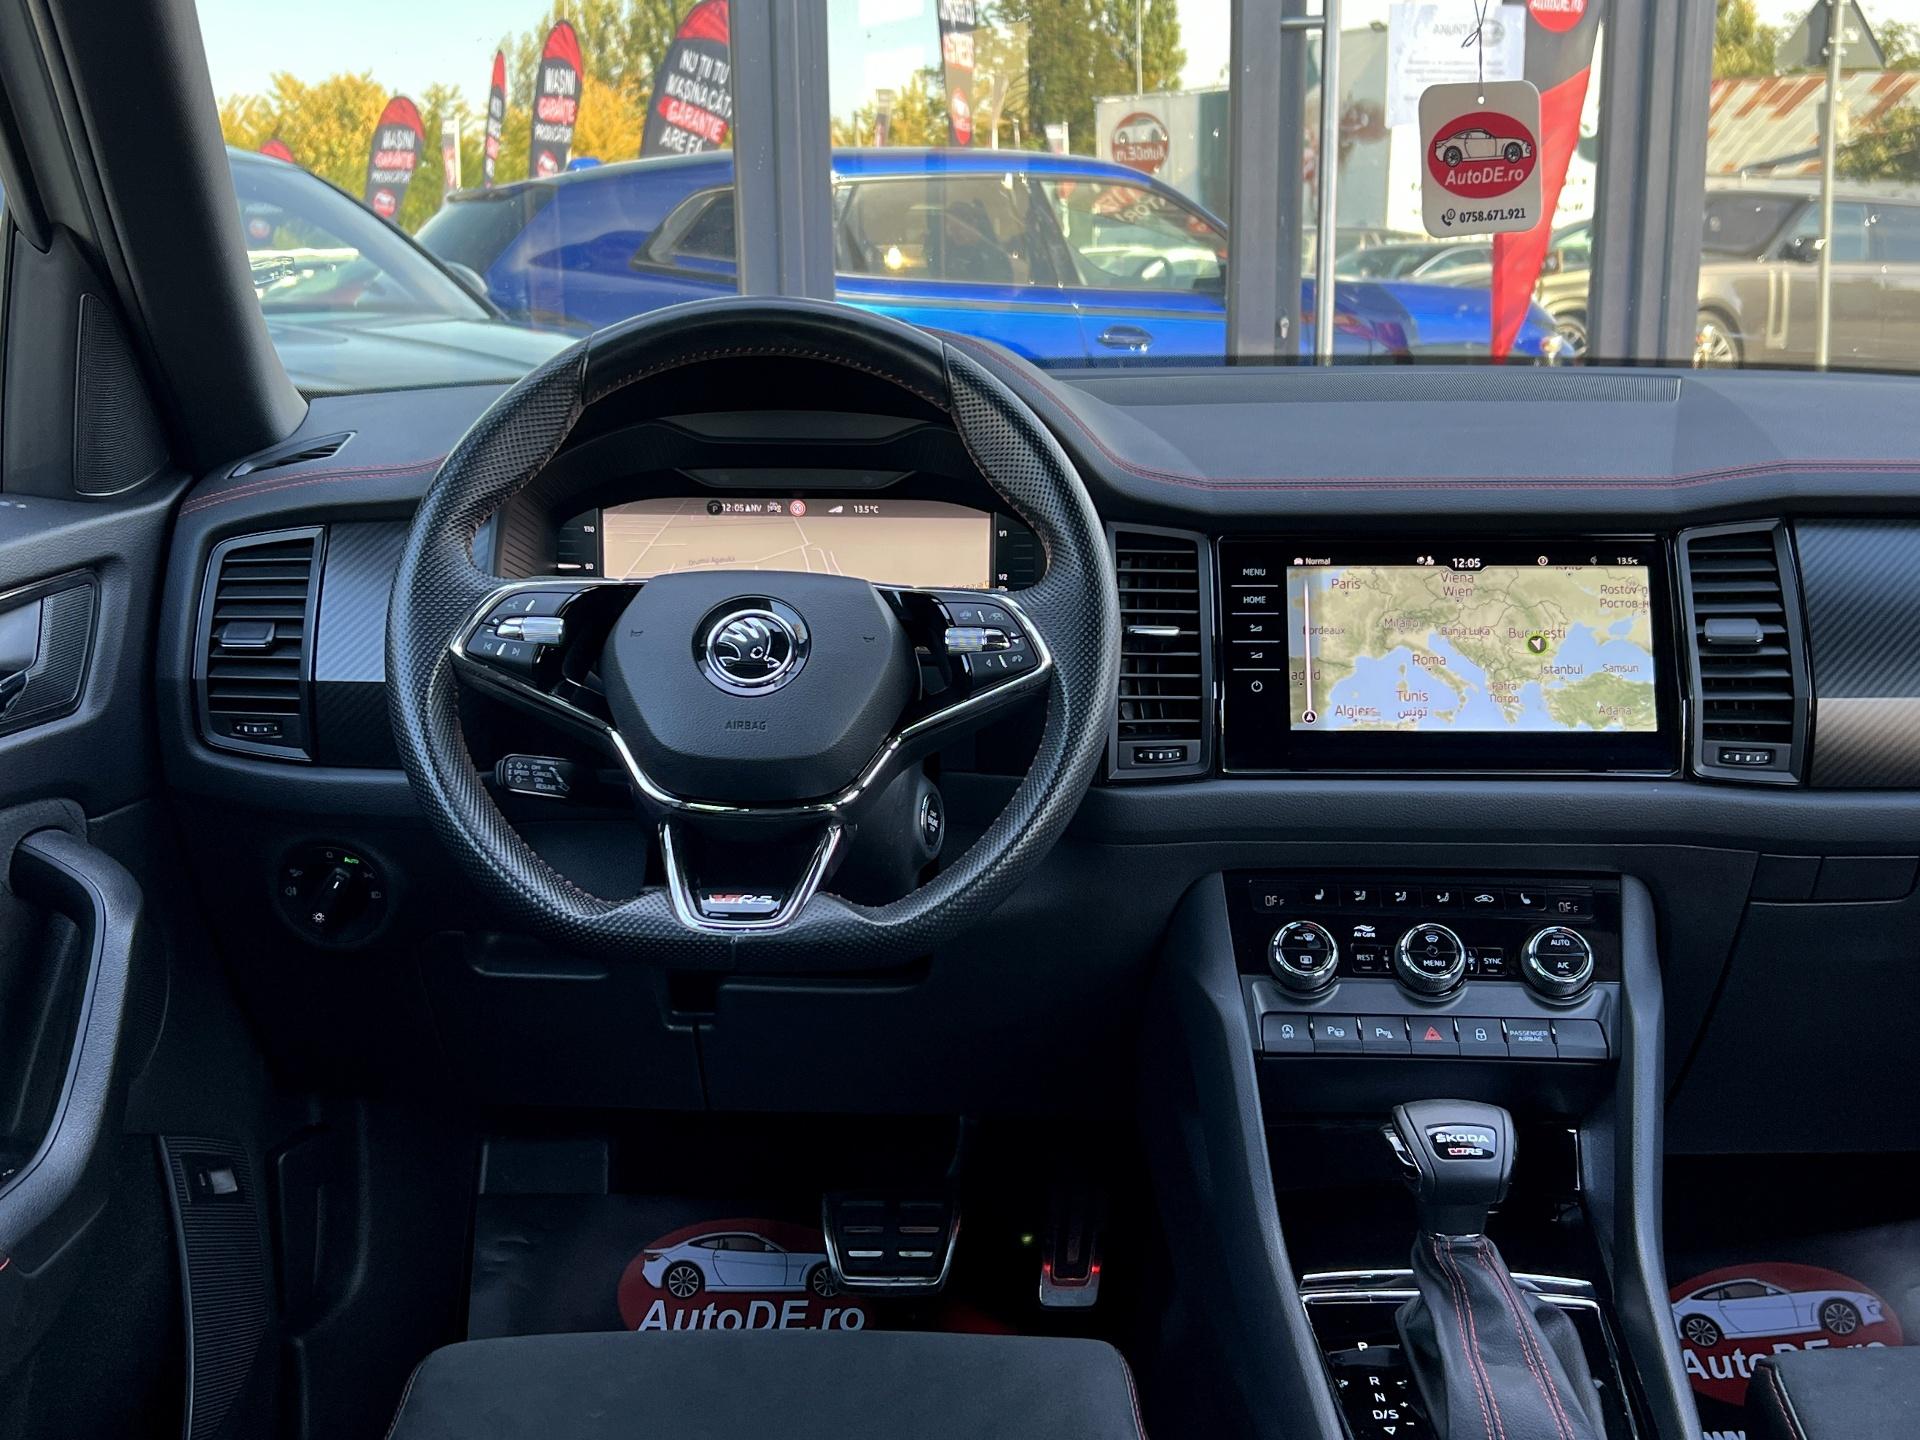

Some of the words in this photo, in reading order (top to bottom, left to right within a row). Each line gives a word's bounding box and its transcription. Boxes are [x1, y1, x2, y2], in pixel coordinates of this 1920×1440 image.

[1445, 166, 1524, 186] AutoDE.ro
[1460, 208, 1526, 223] 0758.671.921
[722, 503, 744, 512] 12:05
[1305, 557, 1331, 565] Normal
[1452, 558, 1481, 568] 12:05
[1243, 568, 1266, 576] MENU
[1441, 572, 1474, 583] Viena
[1331, 578, 1361, 590] Paris
[1443, 586, 1473, 597] Wien
[1243, 596, 1266, 604] HOME
[1303, 626, 1345, 635] ordeaux
[1469, 627, 1490, 636] Luka
[1412, 654, 1446, 665] Roma
[1602, 664, 1639, 673] Samsun
[1396, 690, 1428, 701] Tunis
[1598, 705, 1632, 716] Adana
[725, 720, 767, 730] AIRBAG
[1423, 959, 1446, 967] MENU
[1483, 957, 1502, 965] SYNC
[1557, 961, 1569, 969] A/C
[637, 1299, 865, 1331] AutoDE.ro
[1357, 1341, 1368, 1352] P
[1369, 1376, 1381, 1386] R
[1374, 1392, 1386, 1402] N
[1372, 1409, 1399, 1420] D/S
